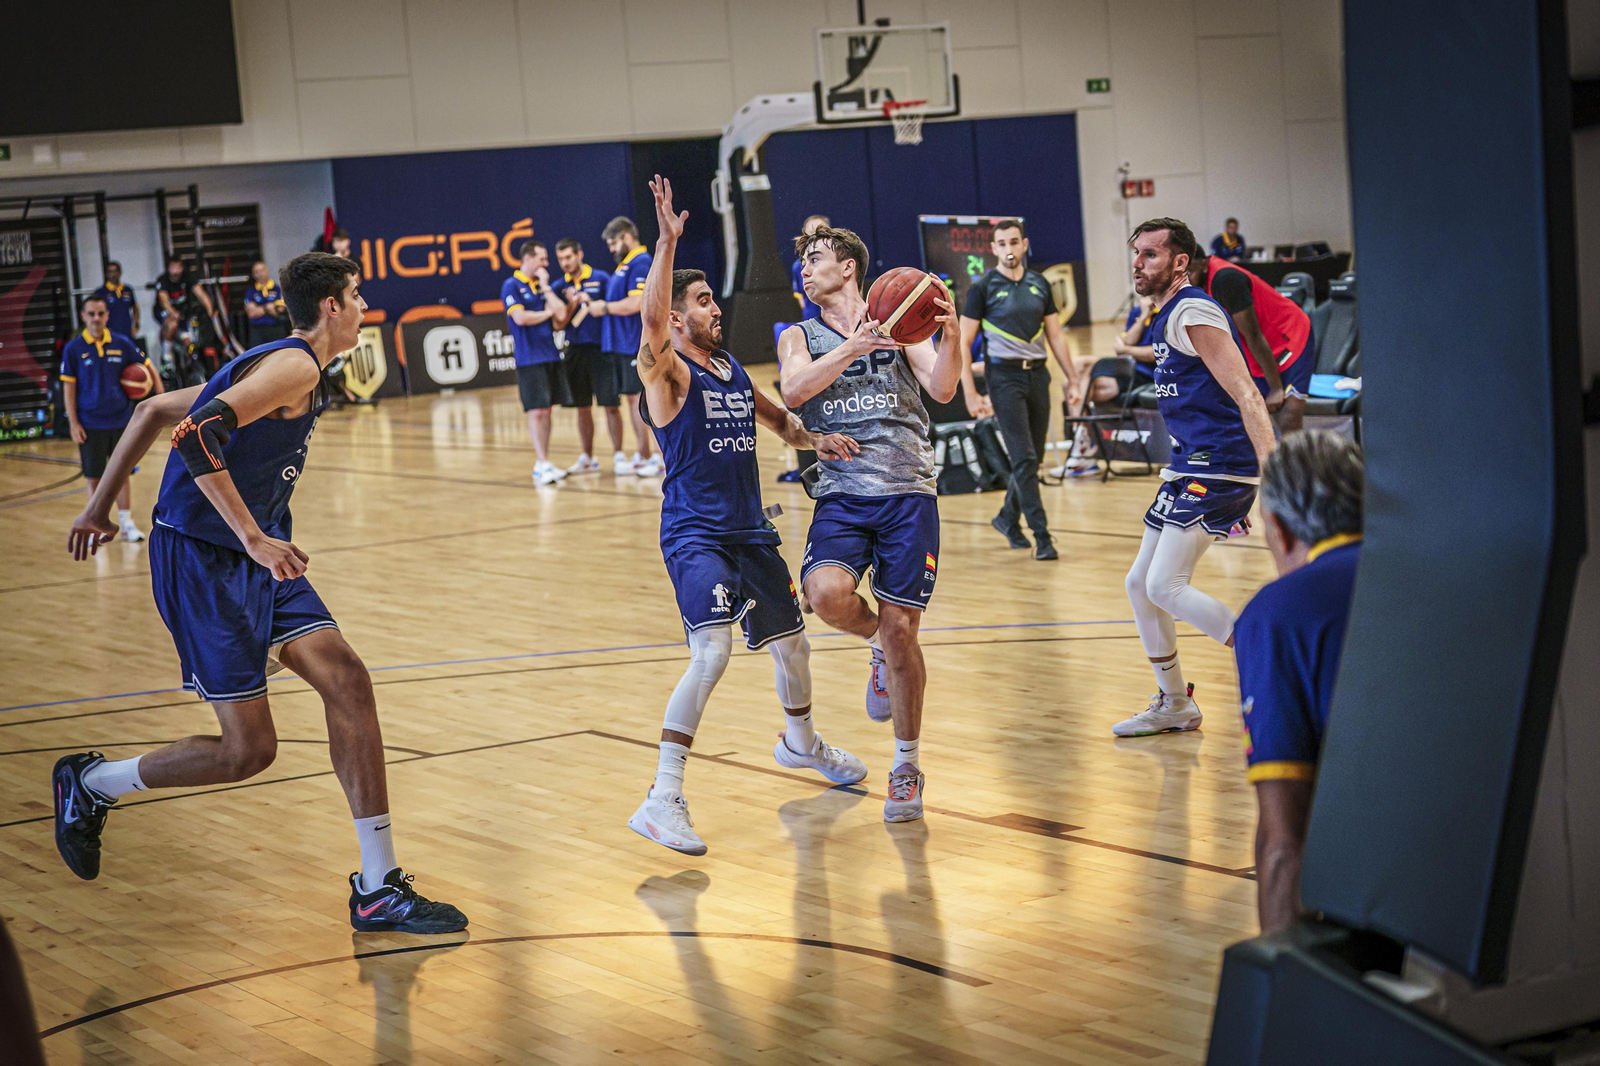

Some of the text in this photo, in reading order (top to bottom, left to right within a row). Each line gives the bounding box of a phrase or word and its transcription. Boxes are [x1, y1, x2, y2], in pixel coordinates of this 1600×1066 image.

[966, 254, 985, 275] 24
[439, 338, 463, 370] fi
[1154, 382, 1179, 398] esa
[822, 391, 899, 415] endesa
[708, 432, 757, 453] ende
[1180, 492, 1202, 502] ESP
